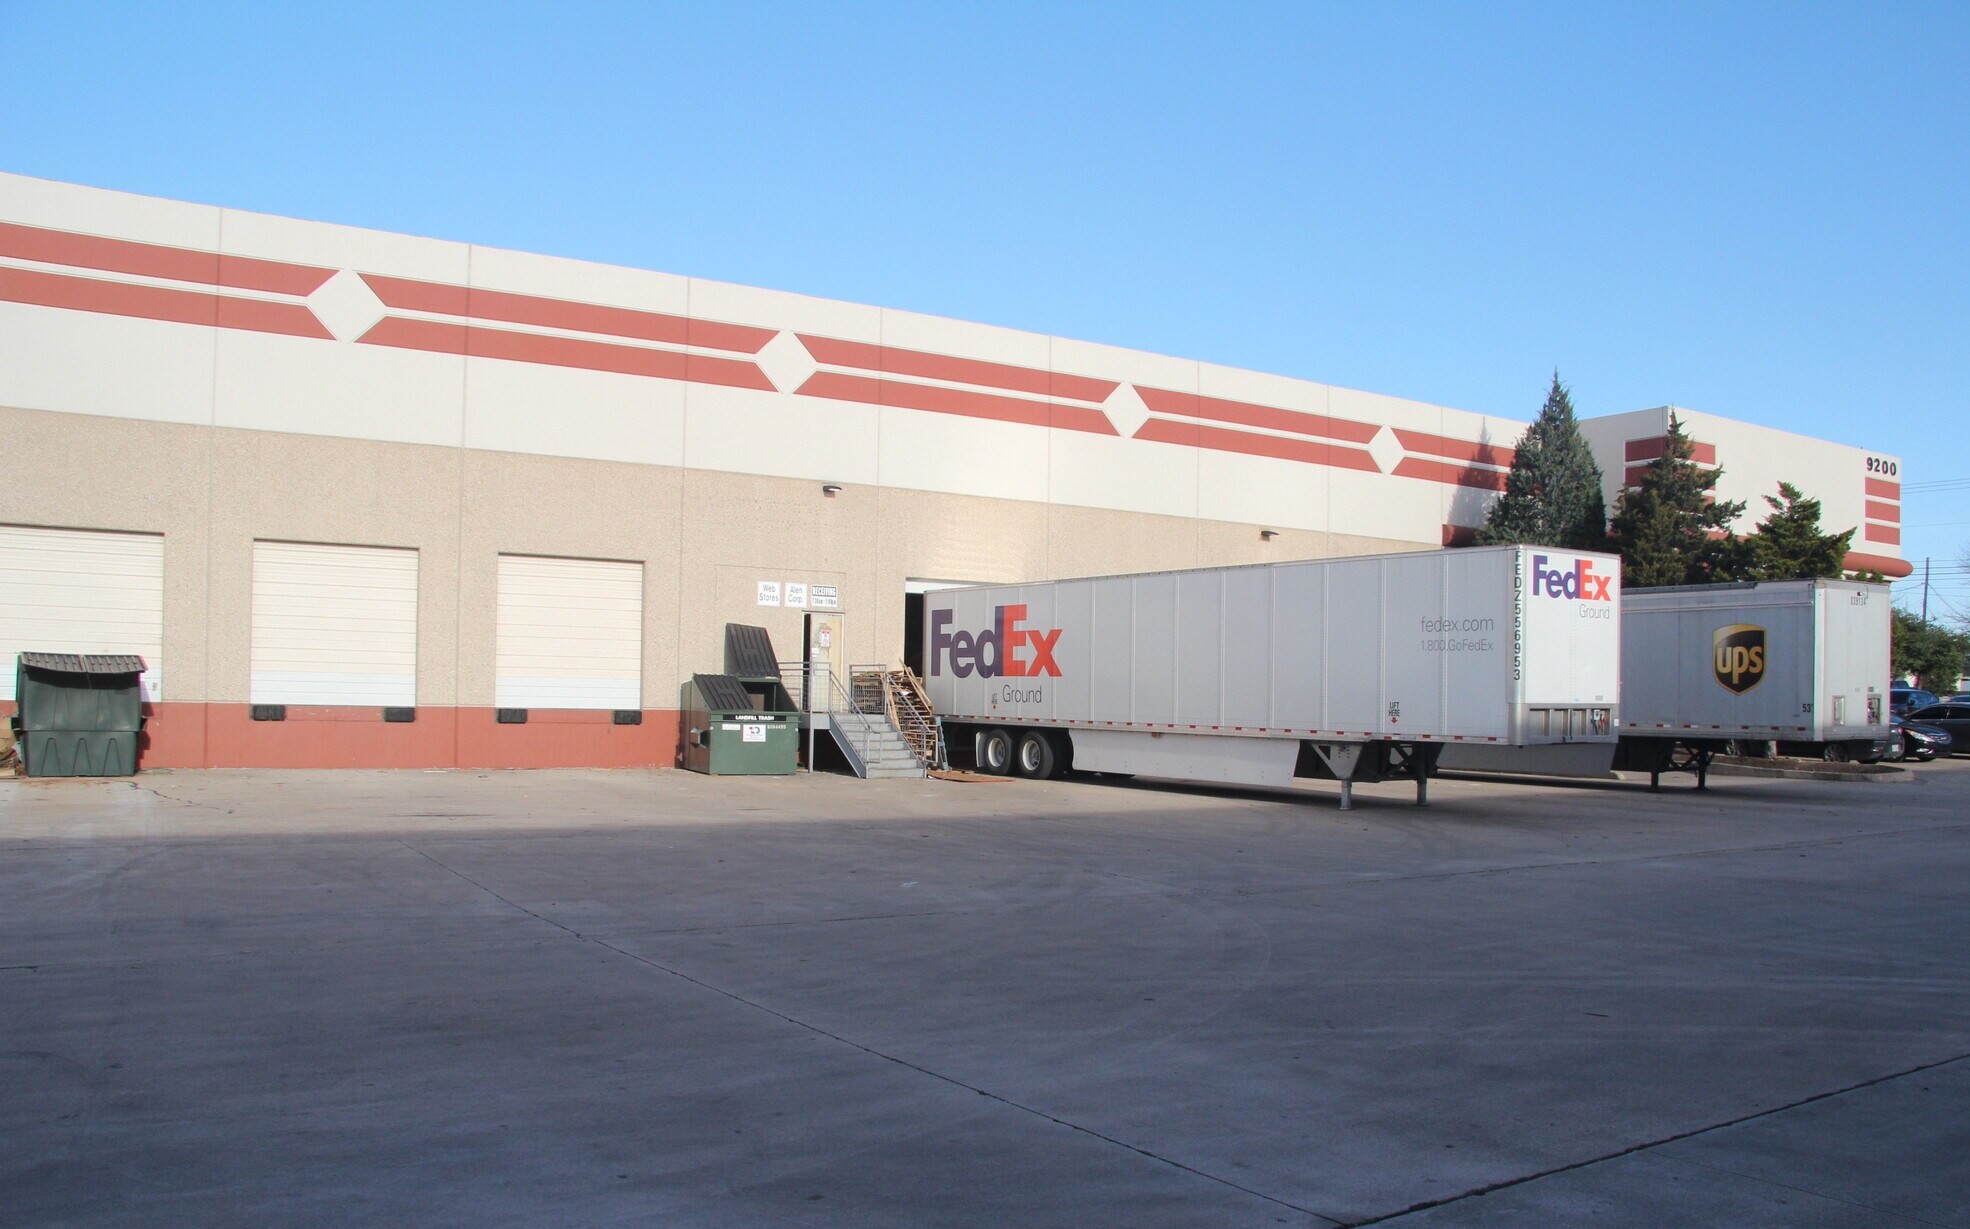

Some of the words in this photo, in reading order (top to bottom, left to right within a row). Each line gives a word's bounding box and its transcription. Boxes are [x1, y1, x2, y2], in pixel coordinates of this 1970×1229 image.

[1866, 457, 1897, 477] 9200
[1532, 554, 1612, 602] FedEx
[762, 584, 776, 593] Web
[759, 593, 779, 602] Stores
[787, 595, 803, 604] Corp.
[1578, 603, 1611, 620] Ground
[1420, 615, 1494, 633] fedex.com
[931, 604, 1063, 679] FedEx
[1716, 646, 1763, 684] ups
[1002, 684, 1042, 704] Ground
[1388, 709, 1401, 717] HERE
[1389, 701, 1400, 709] LIFT
